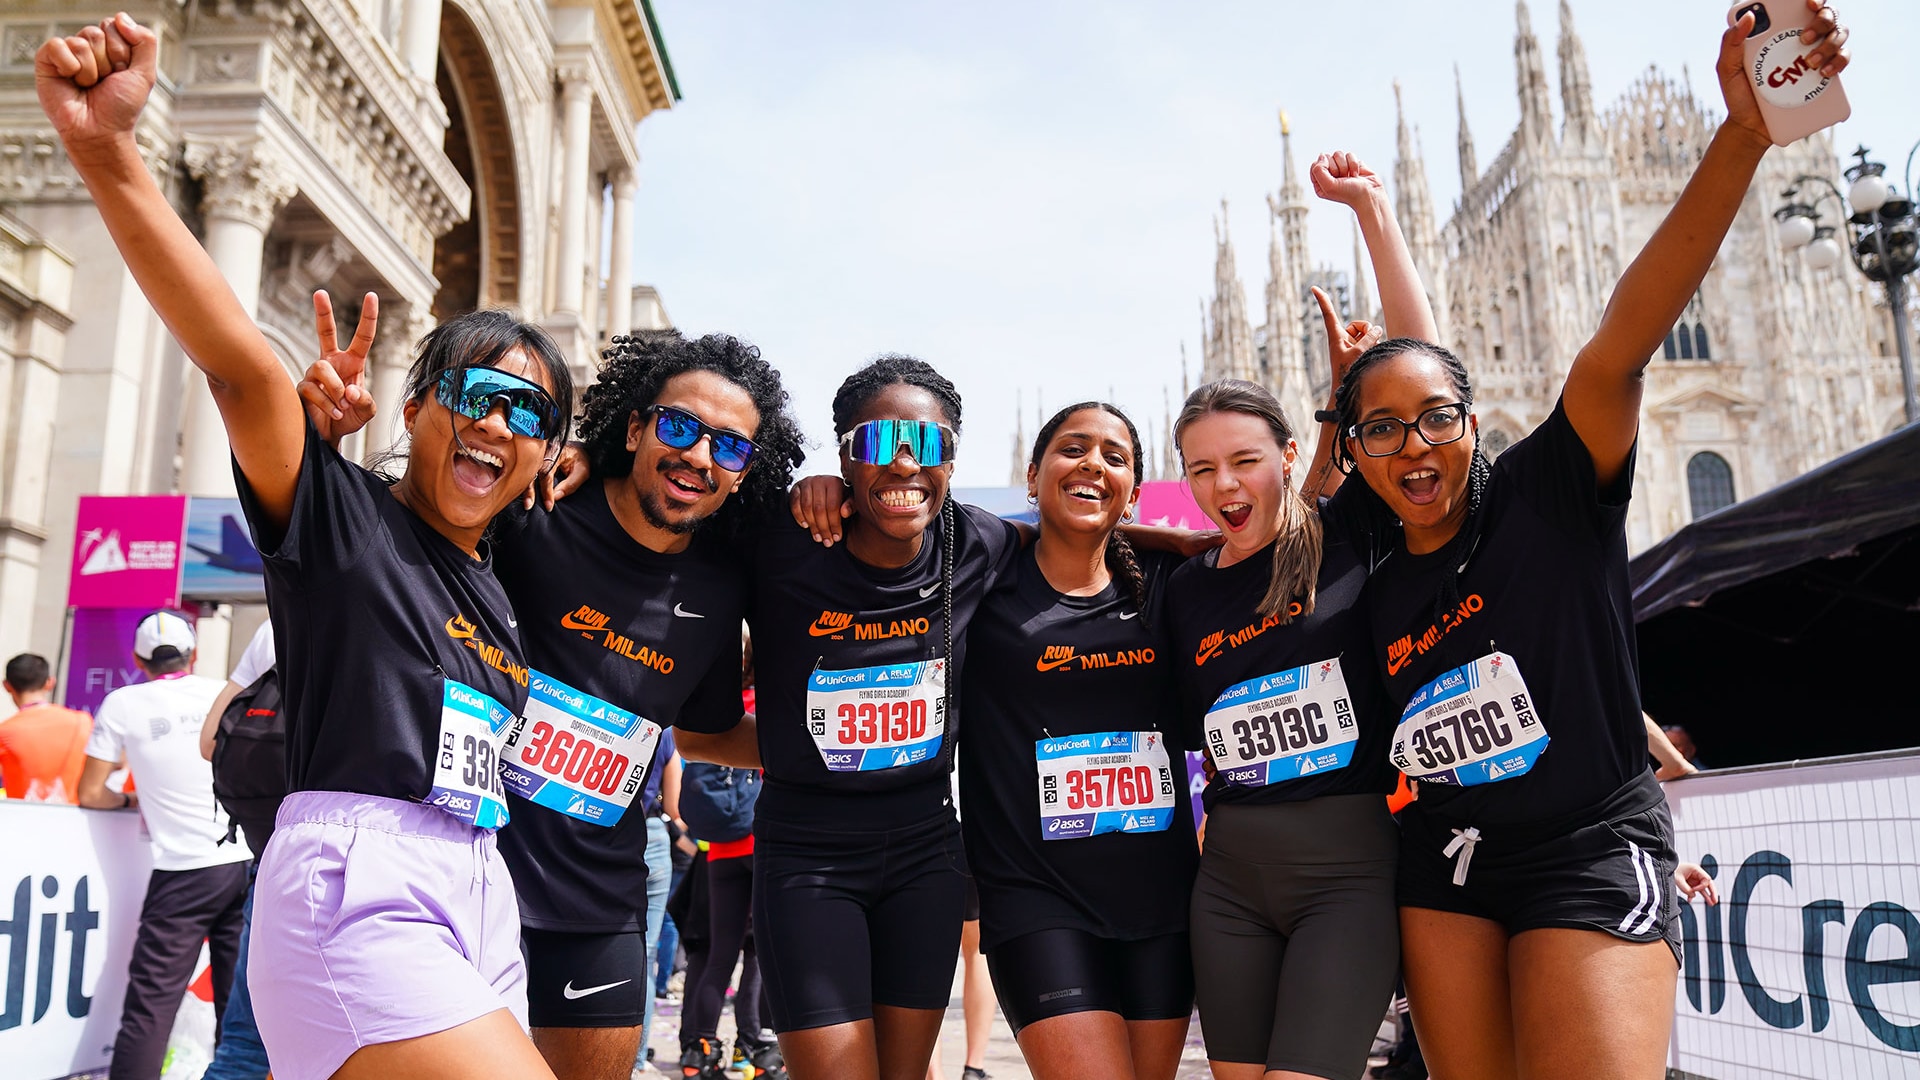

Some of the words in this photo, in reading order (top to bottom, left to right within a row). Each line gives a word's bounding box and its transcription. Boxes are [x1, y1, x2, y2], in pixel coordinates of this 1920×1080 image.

[1755, 46, 1770, 87] SCHOLAR
[1773, 29, 1803, 44] LEADE
[1767, 55, 1809, 88] CM
[1804, 76, 1831, 101] ATHLET
[818, 610, 854, 627] RUN
[854, 617, 930, 640] MILANO
[1199, 629, 1224, 652] RUN
[1229, 601, 1302, 648] MILAO
[575, 604, 610, 628] RUN
[602, 632, 675, 675] MILANO
[1387, 634, 1412, 661] RUN
[1044, 645, 1075, 660] RUN
[1081, 648, 1155, 670] MILANO
[85, 667, 141, 694] FLY
[826, 673, 865, 685] UniCredit
[890, 668, 912, 677] RELAY
[1271, 673, 1293, 685] RELAY
[1442, 673, 1462, 688] RELAY
[543, 685, 584, 709] UniCredit
[858, 690, 874, 699] FLYING
[874, 690, 887, 698] GIRLS
[887, 689, 907, 698] ACADEMY
[1219, 685, 1249, 702] UniCredit
[1247, 703, 1262, 713] FLYING
[1261, 700, 1274, 710] GIRLS
[1274, 695, 1295, 707] ACADEMY
[607, 711, 629, 724] RELAY
[837, 699, 927, 744] 3313D
[1232, 702, 1328, 761] 3313C
[1411, 700, 1513, 769] 3576C
[521, 720, 629, 796] 3608D
[1054, 739, 1091, 752] UniCredit
[463, 735, 505, 799] 331
[504, 768, 532, 787] asics
[1236, 769, 1257, 781] asics
[1066, 765, 1154, 810] 3576D
[1060, 819, 1084, 829] asics
